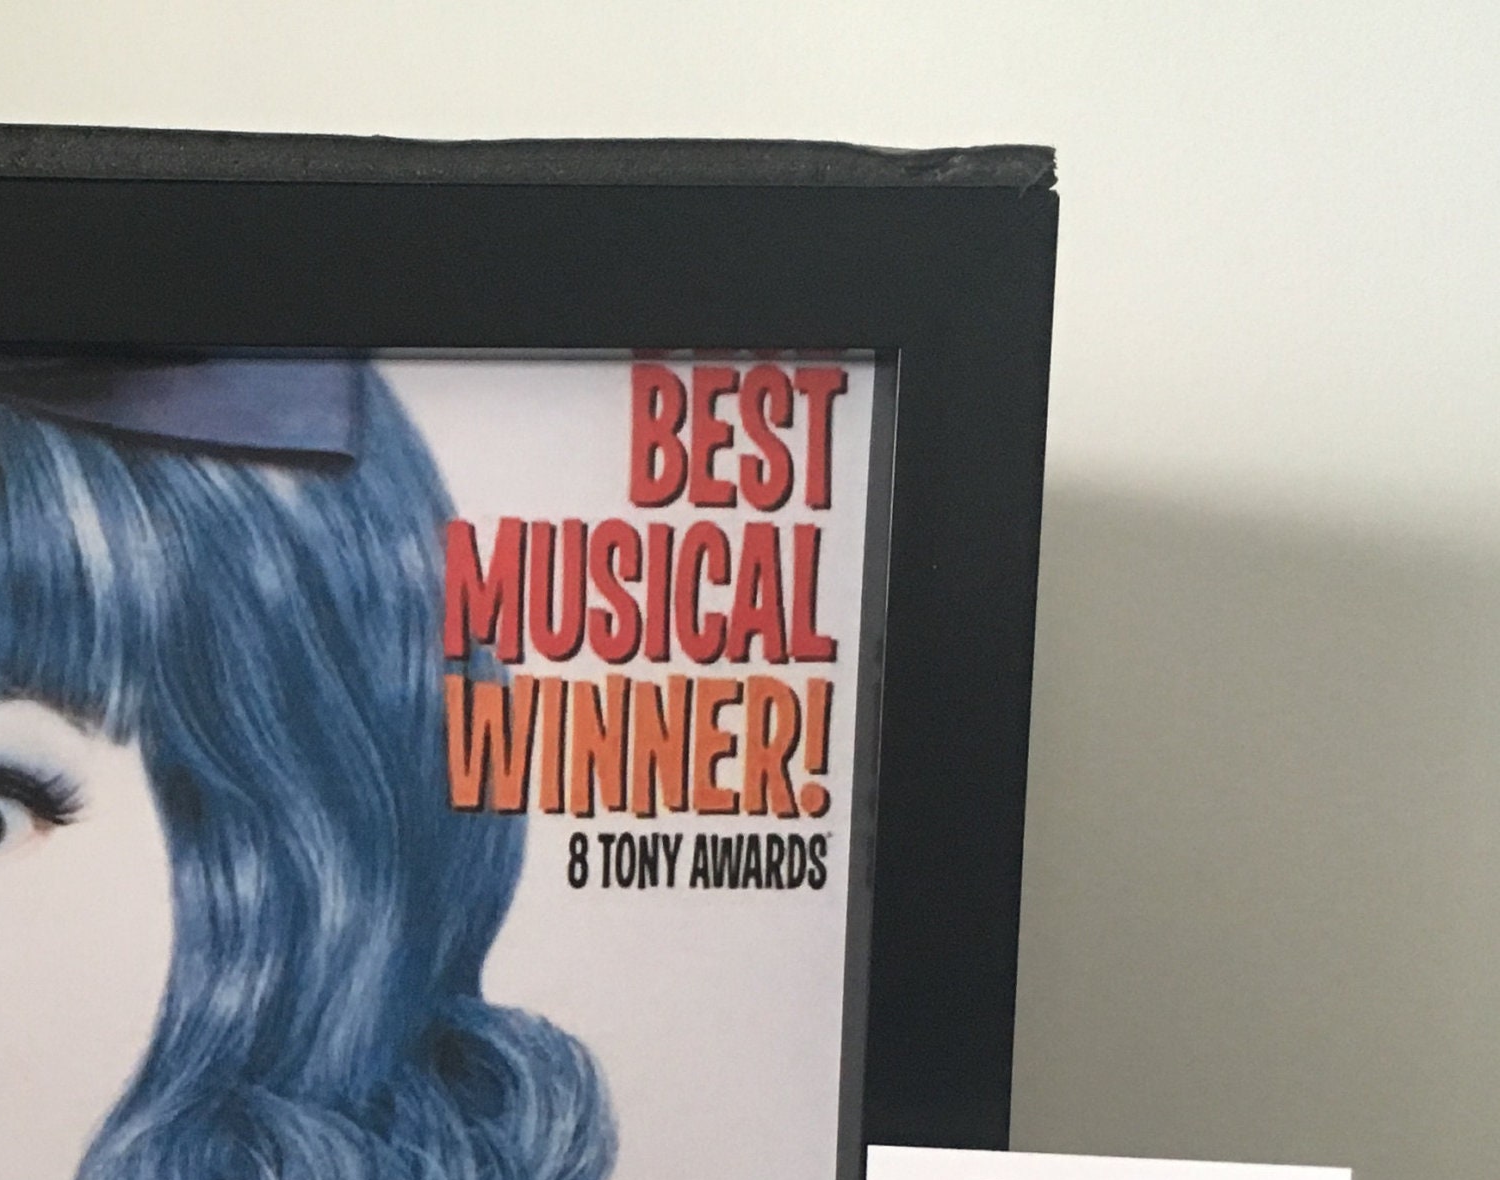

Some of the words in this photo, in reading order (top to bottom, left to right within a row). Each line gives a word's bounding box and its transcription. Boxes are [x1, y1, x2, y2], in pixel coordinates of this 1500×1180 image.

[627, 361, 849, 512] BEST
[442, 516, 838, 666] MUSICAL
[443, 672, 834, 819] WINNER!
[567, 833, 590, 889] 8
[598, 833, 684, 890] TONY
